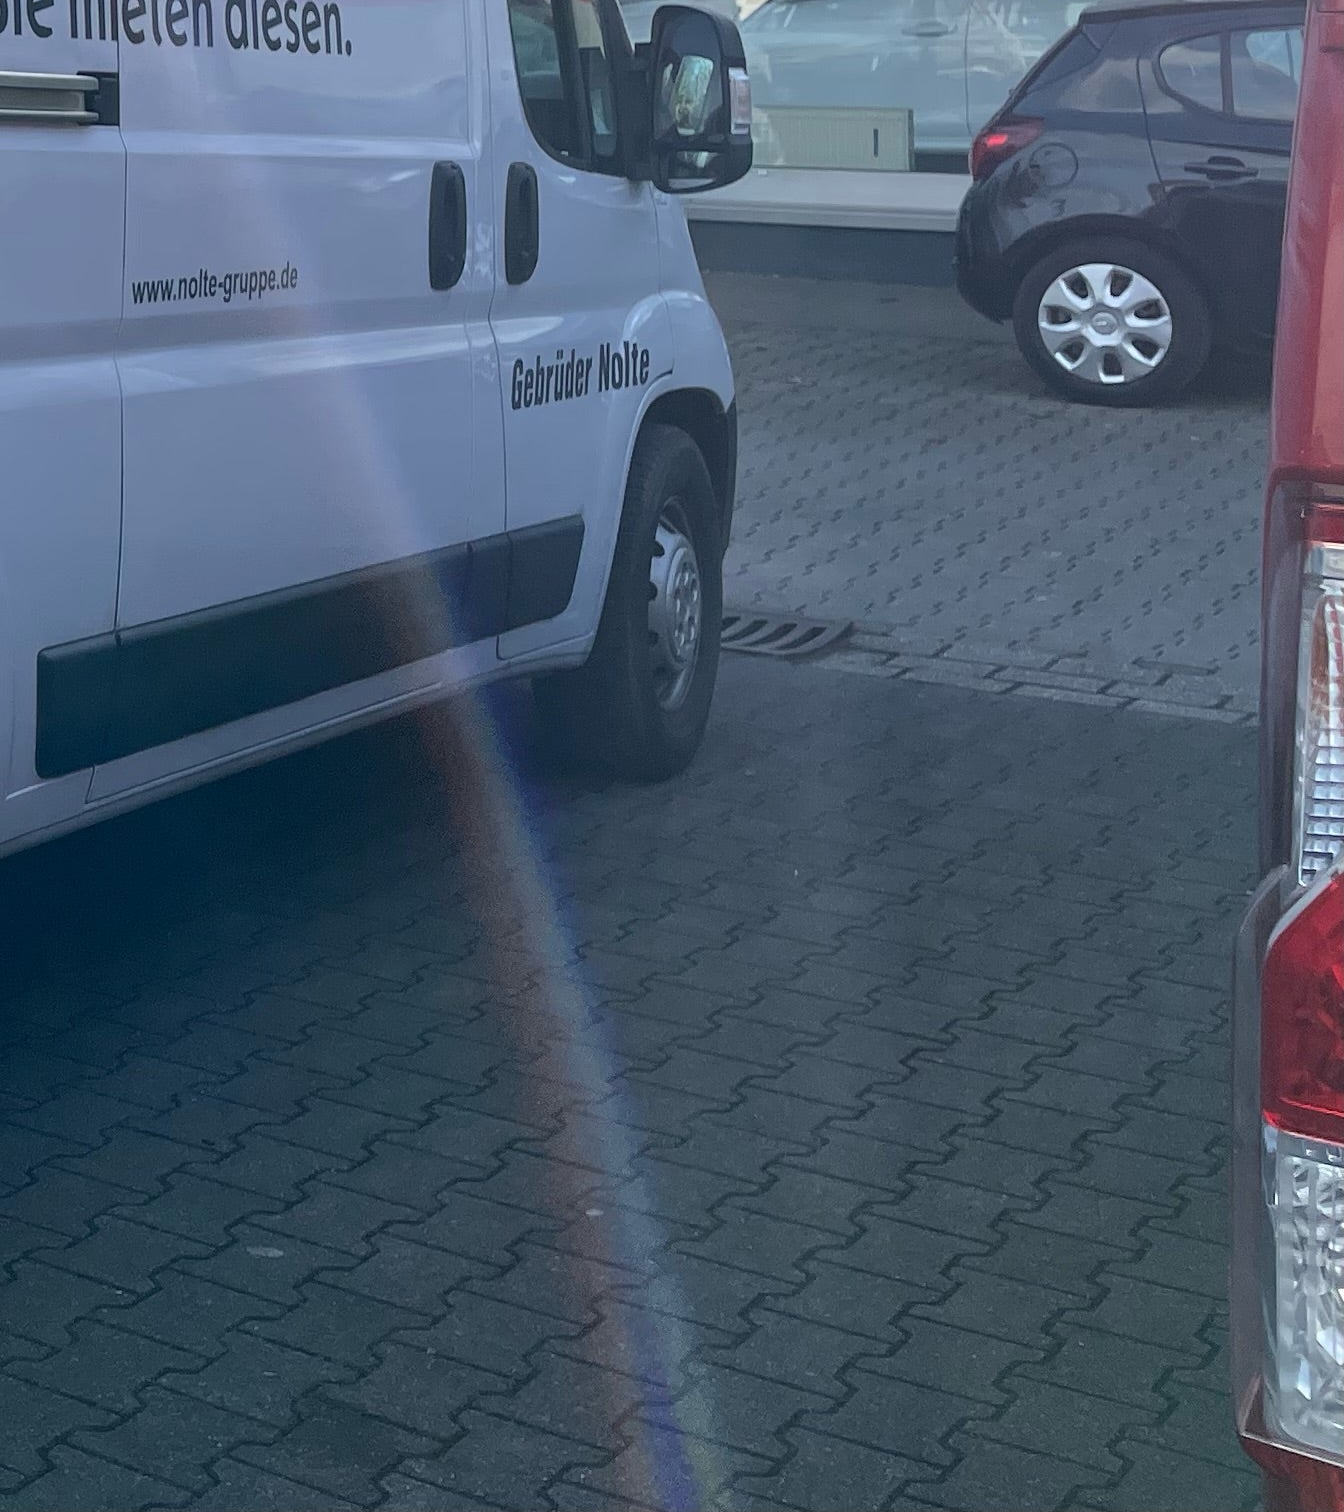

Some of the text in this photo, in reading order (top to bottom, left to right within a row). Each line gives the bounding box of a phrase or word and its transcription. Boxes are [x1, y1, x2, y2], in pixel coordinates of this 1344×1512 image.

[131, 261, 299, 304] www.nolte-gruppe.de
[511, 340, 650, 410] Gebrüder Nolte
